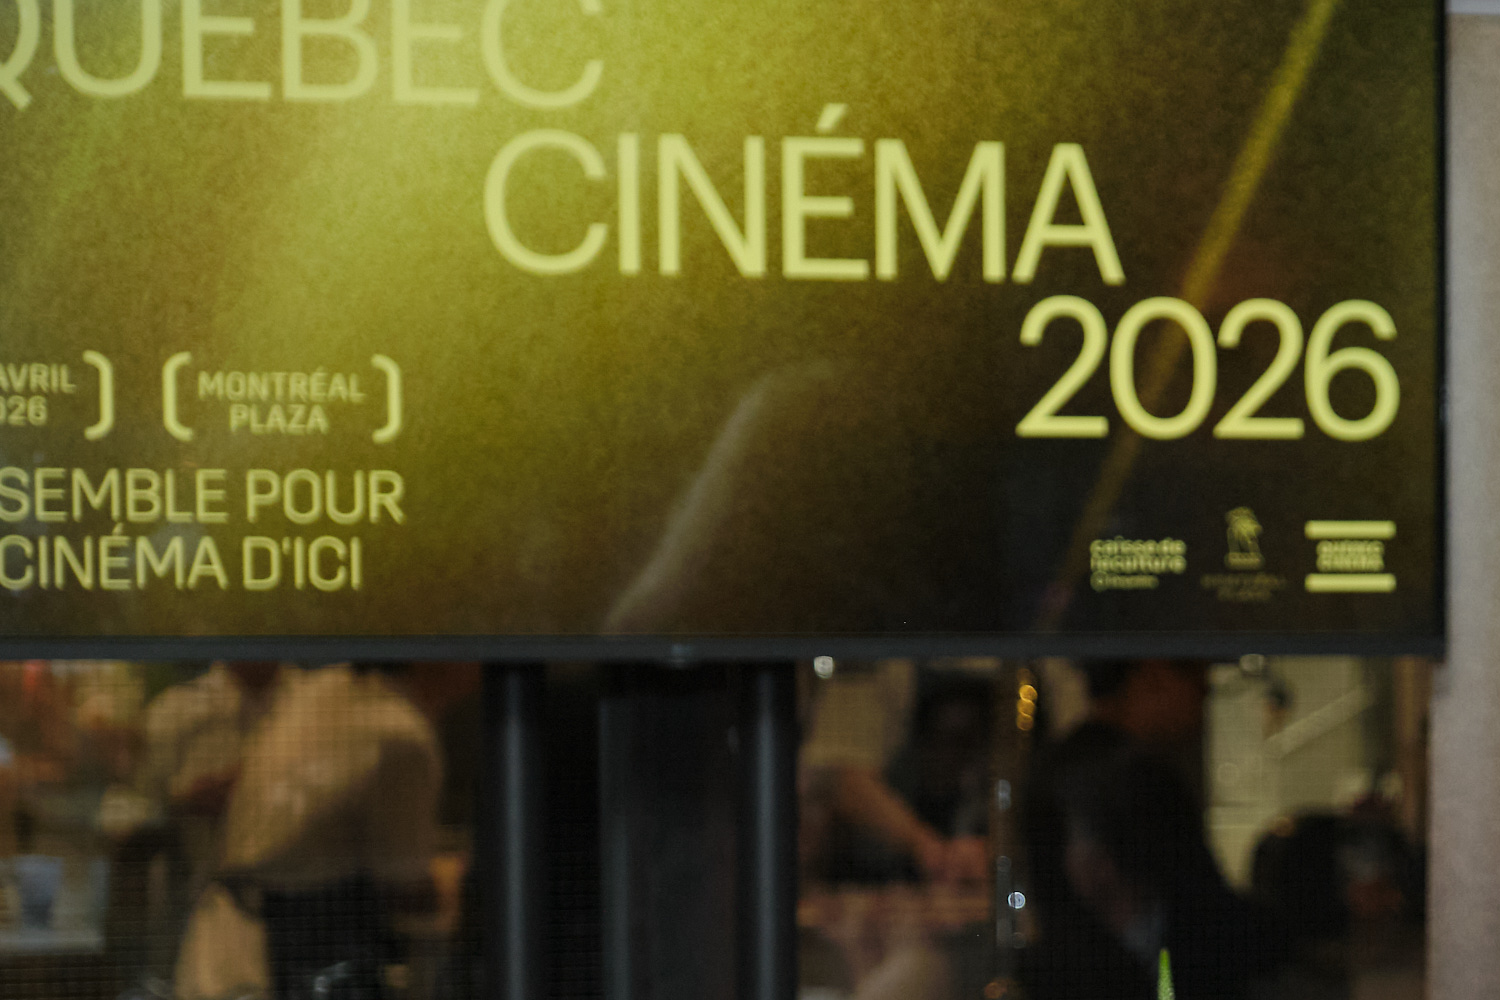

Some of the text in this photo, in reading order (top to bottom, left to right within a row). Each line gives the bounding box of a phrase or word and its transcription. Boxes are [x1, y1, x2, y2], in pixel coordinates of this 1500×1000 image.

[483, 103, 1126, 285] CINÉMA
[198, 366, 366, 402] MONTRÉAL
[1015, 294, 1401, 442] 2026
[229, 404, 329, 435] PLAZA
[246, 469, 406, 525] POUR
[0, 524, 364, 592] CINÉMA D'ICI
